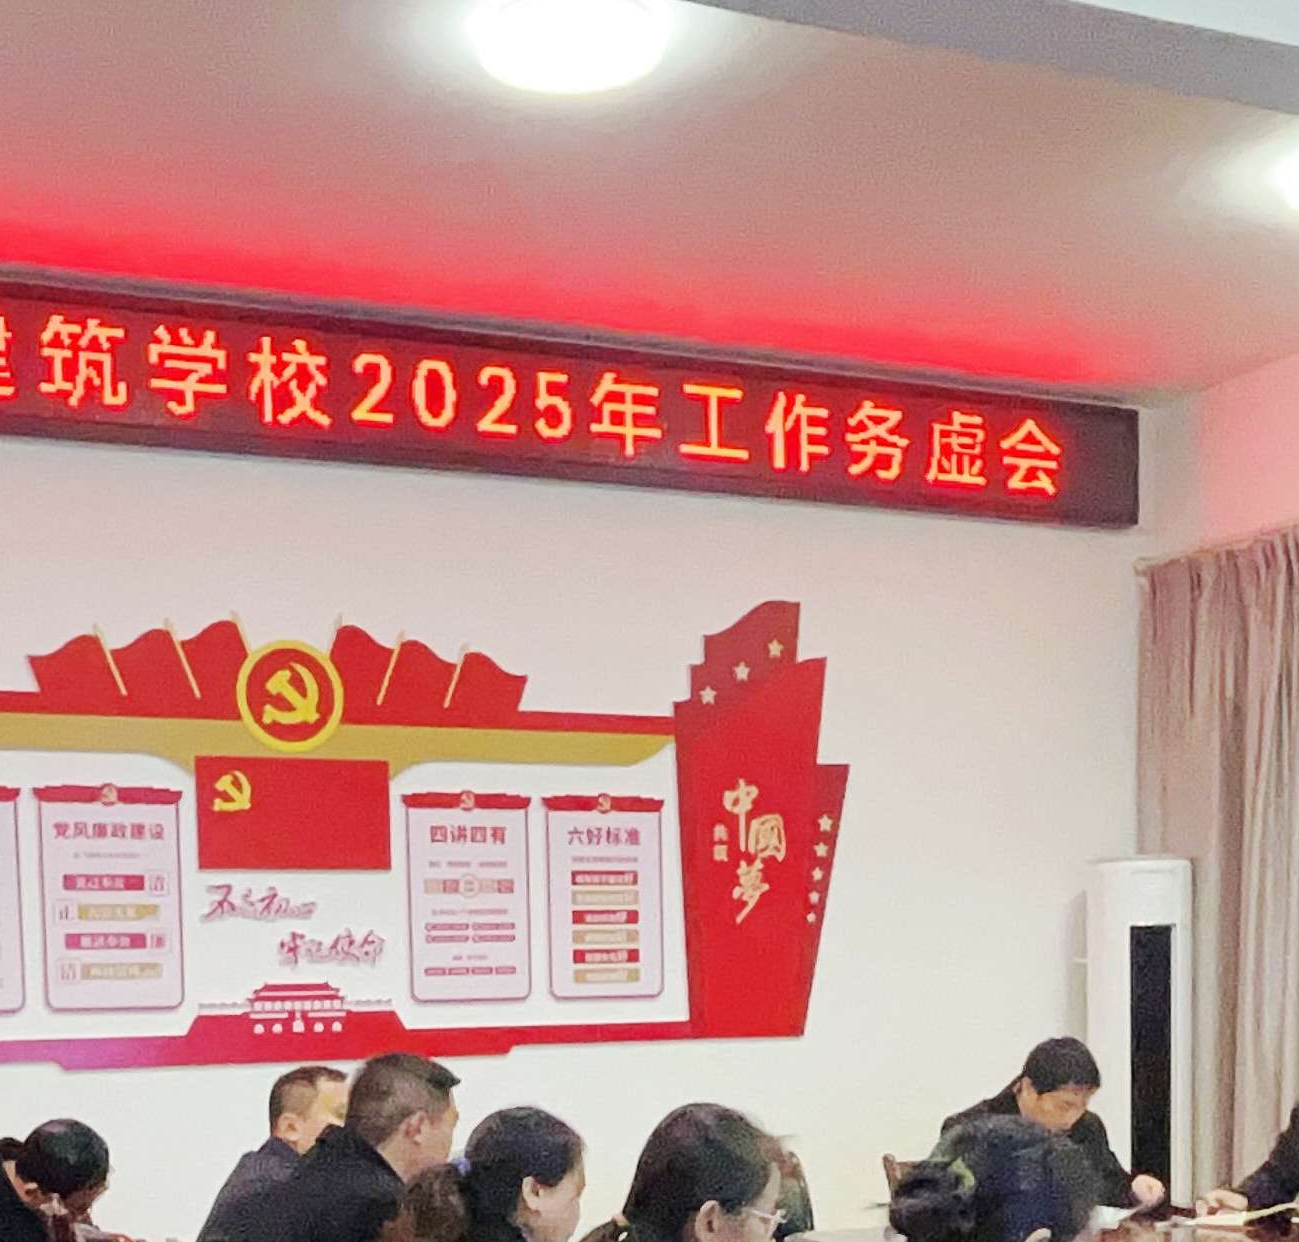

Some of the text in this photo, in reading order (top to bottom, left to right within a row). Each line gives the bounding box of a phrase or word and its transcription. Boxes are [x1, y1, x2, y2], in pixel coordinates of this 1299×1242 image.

[53, 821, 165, 841] 党风廉政建设
[430, 825, 506, 845] 四讲四有
[568, 826, 641, 846] 六好标准
